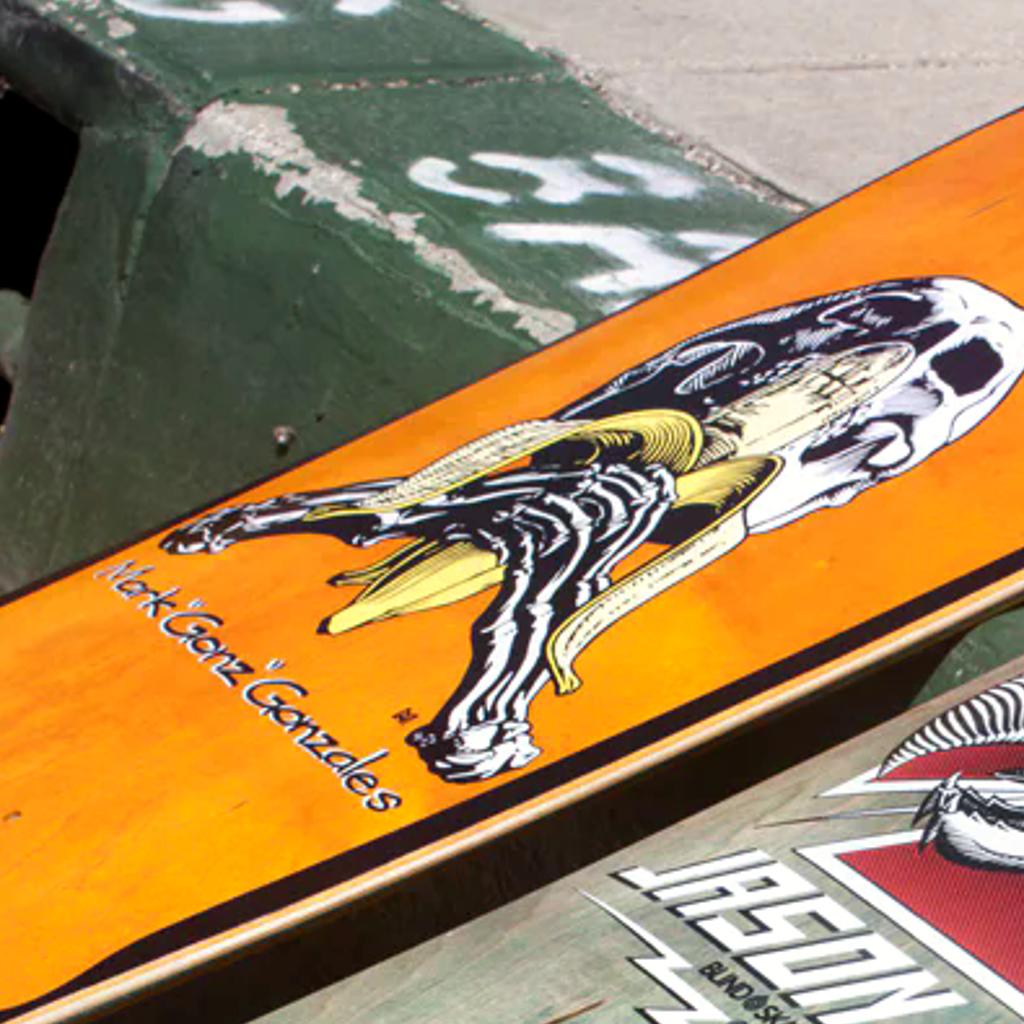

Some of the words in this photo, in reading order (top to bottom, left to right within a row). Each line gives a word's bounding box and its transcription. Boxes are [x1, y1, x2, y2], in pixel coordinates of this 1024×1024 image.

[95, 559, 178, 618] Mark
[243, 678, 403, 813] Gonzales
[698, 960, 755, 1000] BLIND
